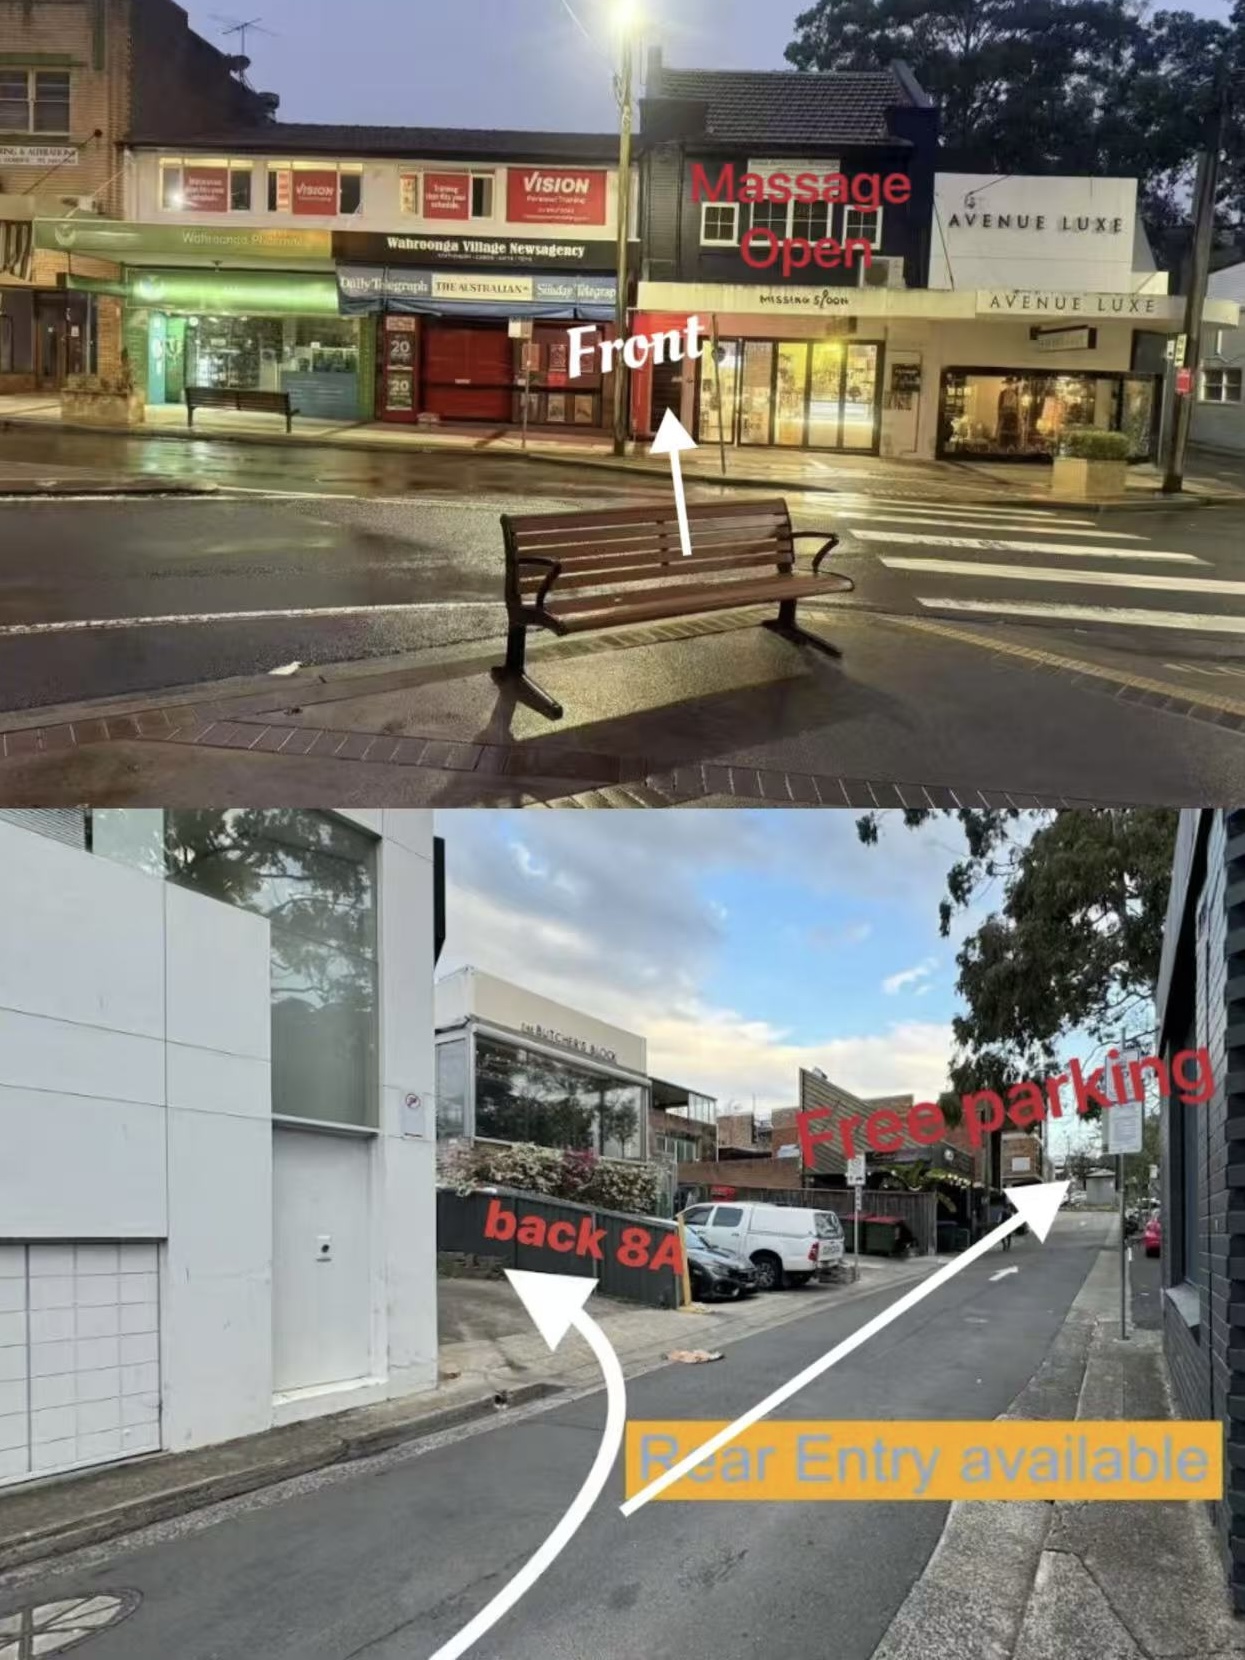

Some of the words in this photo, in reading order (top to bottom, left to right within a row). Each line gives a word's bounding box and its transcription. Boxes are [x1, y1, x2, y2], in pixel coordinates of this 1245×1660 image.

[295, 182, 334, 197] VISION
[523, 171, 590, 194] VISION
[949, 213, 1046, 231] AVENUE
[1061, 216, 1124, 233] LUXE
[386, 236, 458, 253] Wahroonga
[462, 240, 507, 254] Village
[510, 243, 586, 259] Newsagency
[437, 281, 457, 292] THE
[759, 295, 810, 304] MISSING
[989, 296, 1081, 310] AVENUE
[1098, 298, 1156, 313] LUXE
[391, 340, 411, 353] 20
[391, 380, 410, 392] 20
